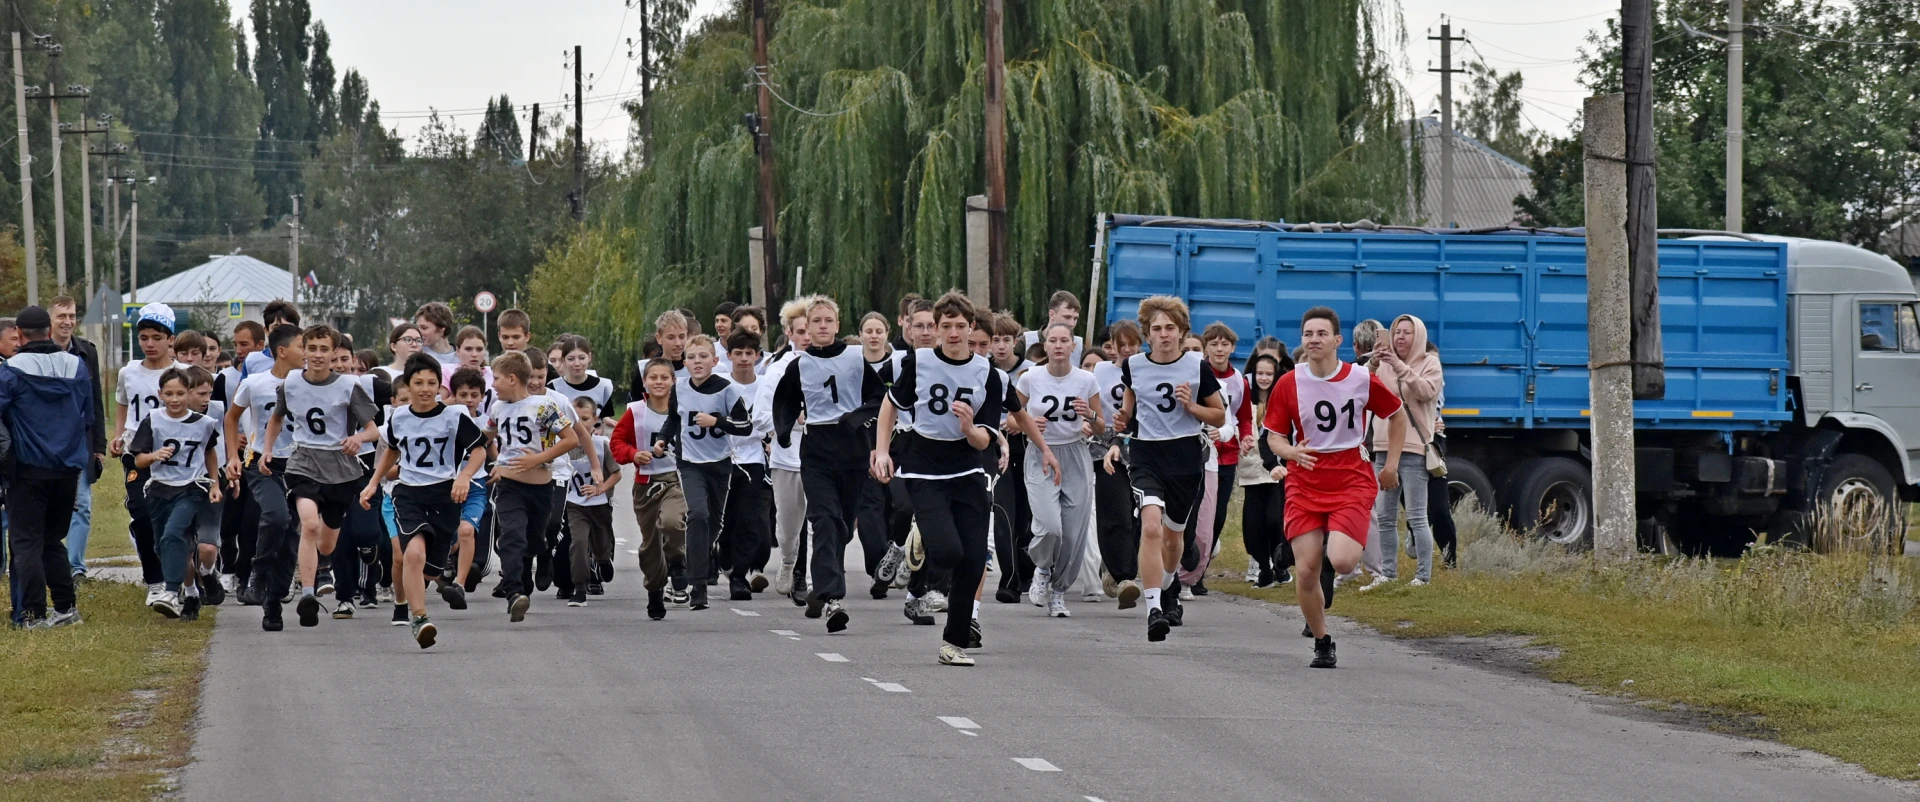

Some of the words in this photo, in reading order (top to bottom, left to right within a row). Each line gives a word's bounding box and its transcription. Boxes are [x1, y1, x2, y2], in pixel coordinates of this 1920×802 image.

[823, 375, 839, 404] 1
[1155, 382, 1177, 413] 3
[306, 407, 326, 435] 6
[1041, 395, 1078, 422] 25
[1314, 398, 1355, 433] 91
[161, 438, 202, 467] 27
[399, 436, 449, 467] 127
